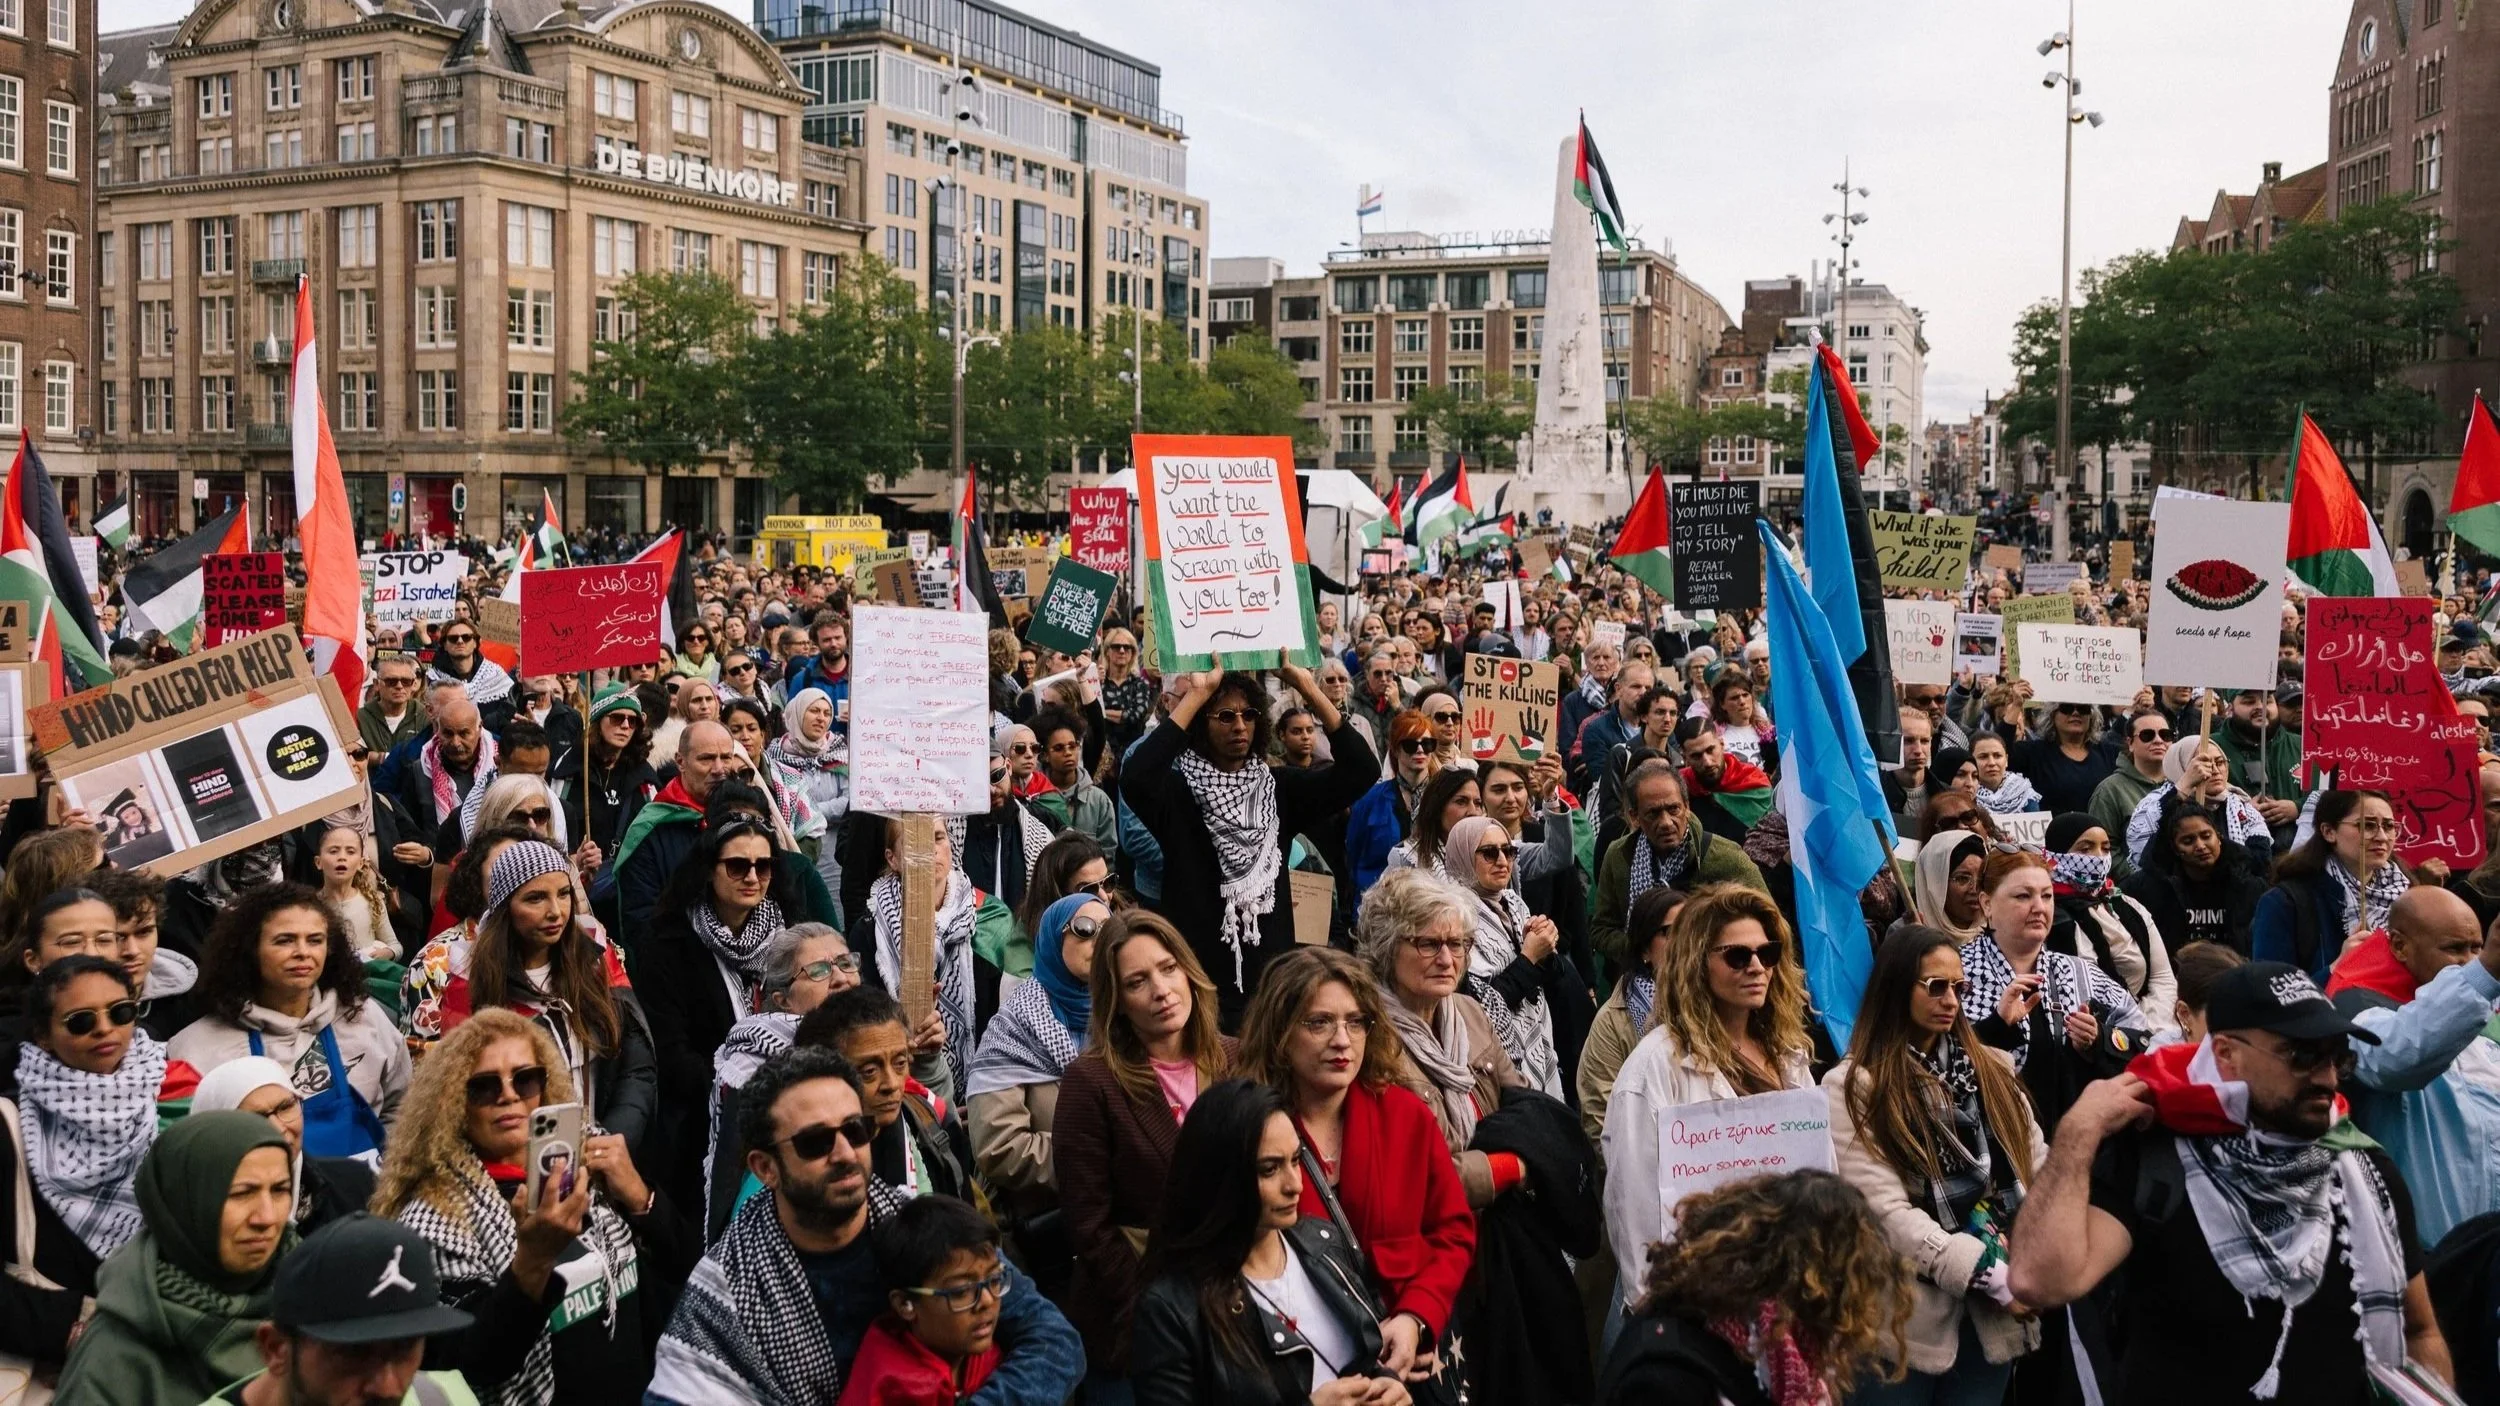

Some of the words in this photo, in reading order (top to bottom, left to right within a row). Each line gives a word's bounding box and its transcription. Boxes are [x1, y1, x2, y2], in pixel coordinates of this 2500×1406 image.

[2337, 71, 2364, 92] TWENTY
[2366, 59, 2391, 79] SEVEN
[598, 143, 642, 178] DE
[647, 153, 798, 207] BIJENKORF
[1218, 459, 1273, 479] would
[1168, 487, 1221, 516] want
[1225, 490, 1263, 513] the
[1698, 487, 1727, 500] MUST
[1675, 507, 1697, 524] YOU
[1700, 503, 1724, 517] MUST
[766, 519, 805, 529] HOTDOGS
[824, 517, 844, 529] HOT
[849, 517, 873, 528] DOGS
[1239, 518, 1266, 544] to
[1675, 525, 1693, 539] TO
[1697, 523, 1729, 537] TELL
[1873, 512, 1914, 533] What
[1919, 517, 1934, 537] if
[1934, 518, 1964, 536] she
[1676, 539, 1693, 555] MY
[1901, 535, 1930, 548] was
[1931, 539, 1968, 555] your
[240, 554, 266, 573] SO
[378, 551, 445, 577] STOP
[1244, 547, 1282, 571] with
[1688, 560, 1725, 573] REFAAT
[920, 573, 933, 581] FREE
[1056, 577, 1073, 590] FROM
[373, 582, 456, 603] azi-Israhel
[1052, 585, 1083, 605] RIVER
[204, 594, 284, 612] PLEASE
[1046, 594, 1094, 626] PALESTINE
[1074, 600, 1099, 618] SEA
[1179, 588, 1232, 629] you
[397, 607, 414, 621] het
[445, 608, 454, 620] is
[888, 614, 910, 623] know
[919, 617, 934, 625] too
[938, 617, 962, 627] well
[1061, 616, 1094, 639] FREE
[1893, 627, 1922, 644] not
[2175, 625, 2205, 637] seeds
[2207, 626, 2221, 639] of
[2223, 626, 2252, 640] hope
[907, 632, 924, 641] our
[2038, 630, 2058, 645] The
[2065, 636, 2112, 649] purpose
[883, 647, 941, 658] incomplete
[1891, 647, 1942, 670] efense
[2068, 645, 2082, 659] of
[2087, 646, 2132, 661] freedom
[871, 660, 913, 670] without
[920, 662, 938, 670] the
[2057, 657, 2071, 670] to
[2075, 661, 2111, 673] create
[131, 666, 208, 723] CALLED
[197, 653, 247, 701] FOR
[236, 632, 296, 690] HELP
[864, 674, 877, 685] of
[885, 675, 901, 685] the
[2050, 667, 2069, 682] for
[2074, 671, 2111, 686] others
[1464, 681, 1492, 700] THE
[859, 717, 876, 726] We
[910, 719, 933, 729] have
[2431, 721, 2477, 740] alestine
[275, 736, 316, 759] JUSTICE
[282, 732, 300, 746] NO
[915, 735, 931, 743] and
[937, 735, 986, 747] HAPPINESS
[1728, 741, 1759, 751] PEAC
[290, 750, 307, 763] NO
[859, 747, 887, 756] until
[900, 748, 916, 756] the
[286, 755, 320, 774] PEACE
[896, 760, 910, 769] do
[189, 773, 229, 795] HIND
[210, 782, 232, 794] found
[879, 775, 900, 785] long
[919, 777, 940, 788] they
[858, 789, 885, 799] enjoy
[1755, 1122, 1778, 1136] we
[1780, 1119, 1828, 1132] sneeuw
[1716, 1158, 1756, 1170] samen
[1759, 1155, 1786, 1166] een
